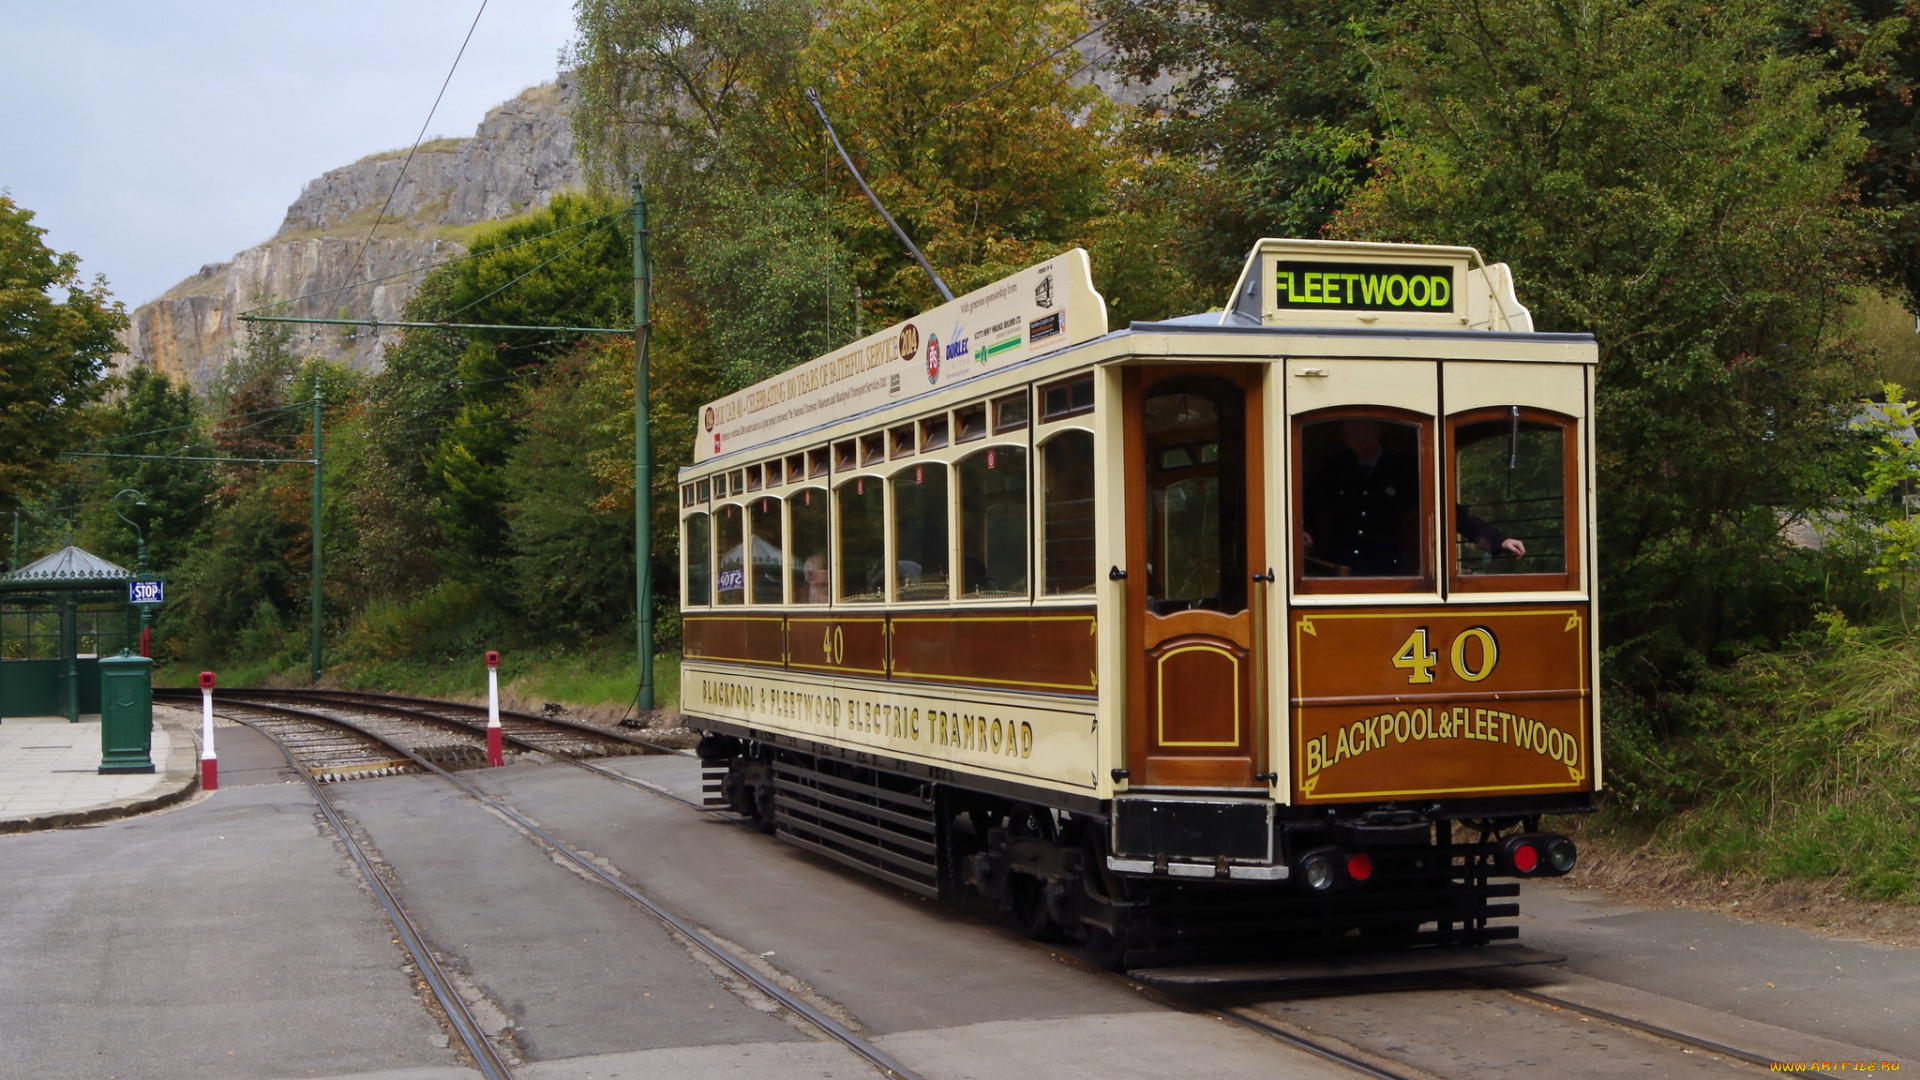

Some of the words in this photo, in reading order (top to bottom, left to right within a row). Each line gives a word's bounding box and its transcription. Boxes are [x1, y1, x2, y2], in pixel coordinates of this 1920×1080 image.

[1277, 271, 1450, 307] FLEETWOOD
[901, 327, 917, 356] 2014
[946, 337, 969, 361] DORLEC
[747, 381, 786, 415] CELEBRATING
[796, 367, 819, 396] YEARS
[820, 362, 828, 388] OF
[829, 349, 866, 385] FAITHFUL
[866, 335, 899, 370] SERVICE
[135, 585, 158, 598] STOP
[823, 625, 843, 665] 40
[1391, 626, 1499, 685] 40
[702, 679, 755, 712] BLACKPOOL
[760, 687, 766, 713] &
[770, 689, 841, 727] FLEETWOOD
[848, 699, 919, 740] ELECTRIC
[927, 709, 1033, 759] TRAMROAD
